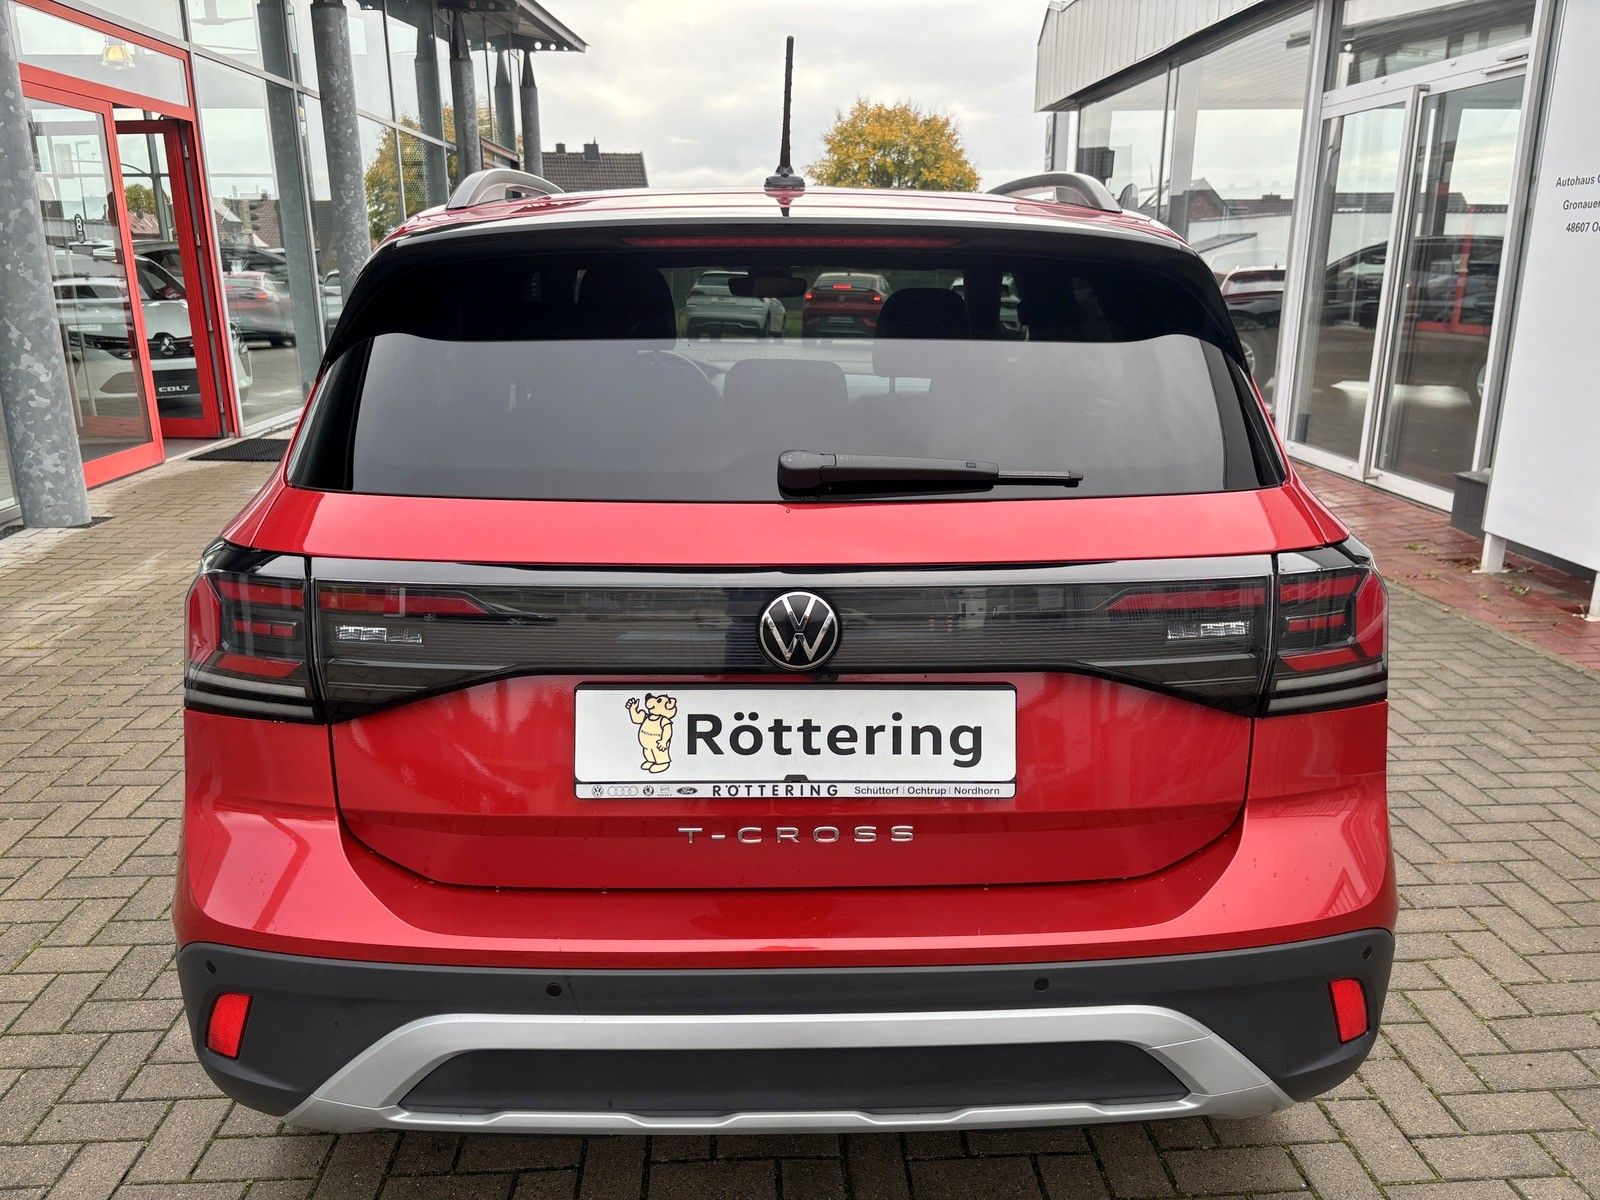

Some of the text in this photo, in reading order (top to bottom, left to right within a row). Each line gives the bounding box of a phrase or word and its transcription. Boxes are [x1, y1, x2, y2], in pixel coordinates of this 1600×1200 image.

[1555, 175, 1595, 187] Autohaus
[1565, 221, 1590, 232] 48607
[687, 711, 982, 768] Röttering
[712, 785, 838, 797] RÖTTERING
[854, 786, 1000, 797] Schüttorf Ochtrup Nordhorn
[678, 825, 914, 844] T-CROSS
